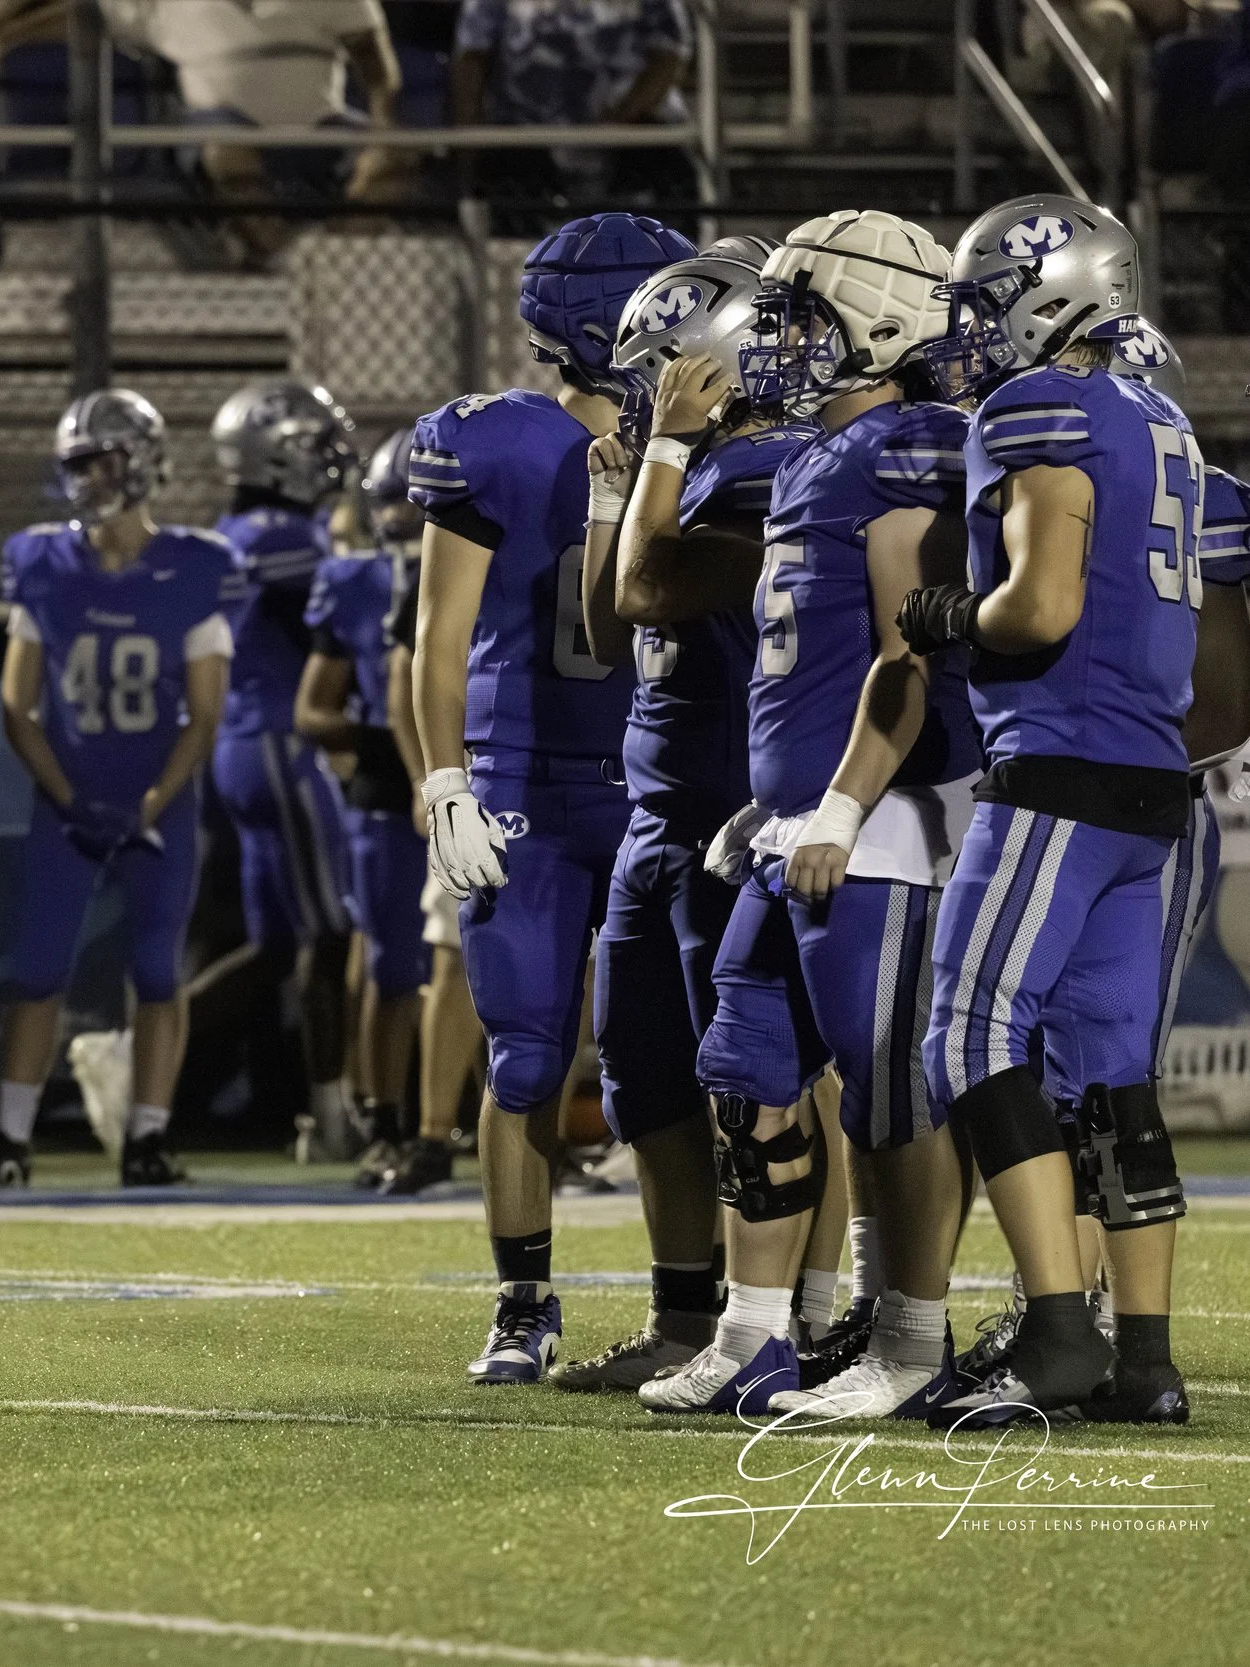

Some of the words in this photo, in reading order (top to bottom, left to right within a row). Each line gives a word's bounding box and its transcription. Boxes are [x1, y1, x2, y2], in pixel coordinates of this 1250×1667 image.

[1110, 295, 1120, 306] 53
[1147, 421, 1206, 611] 53
[60, 633, 160, 734] 48
